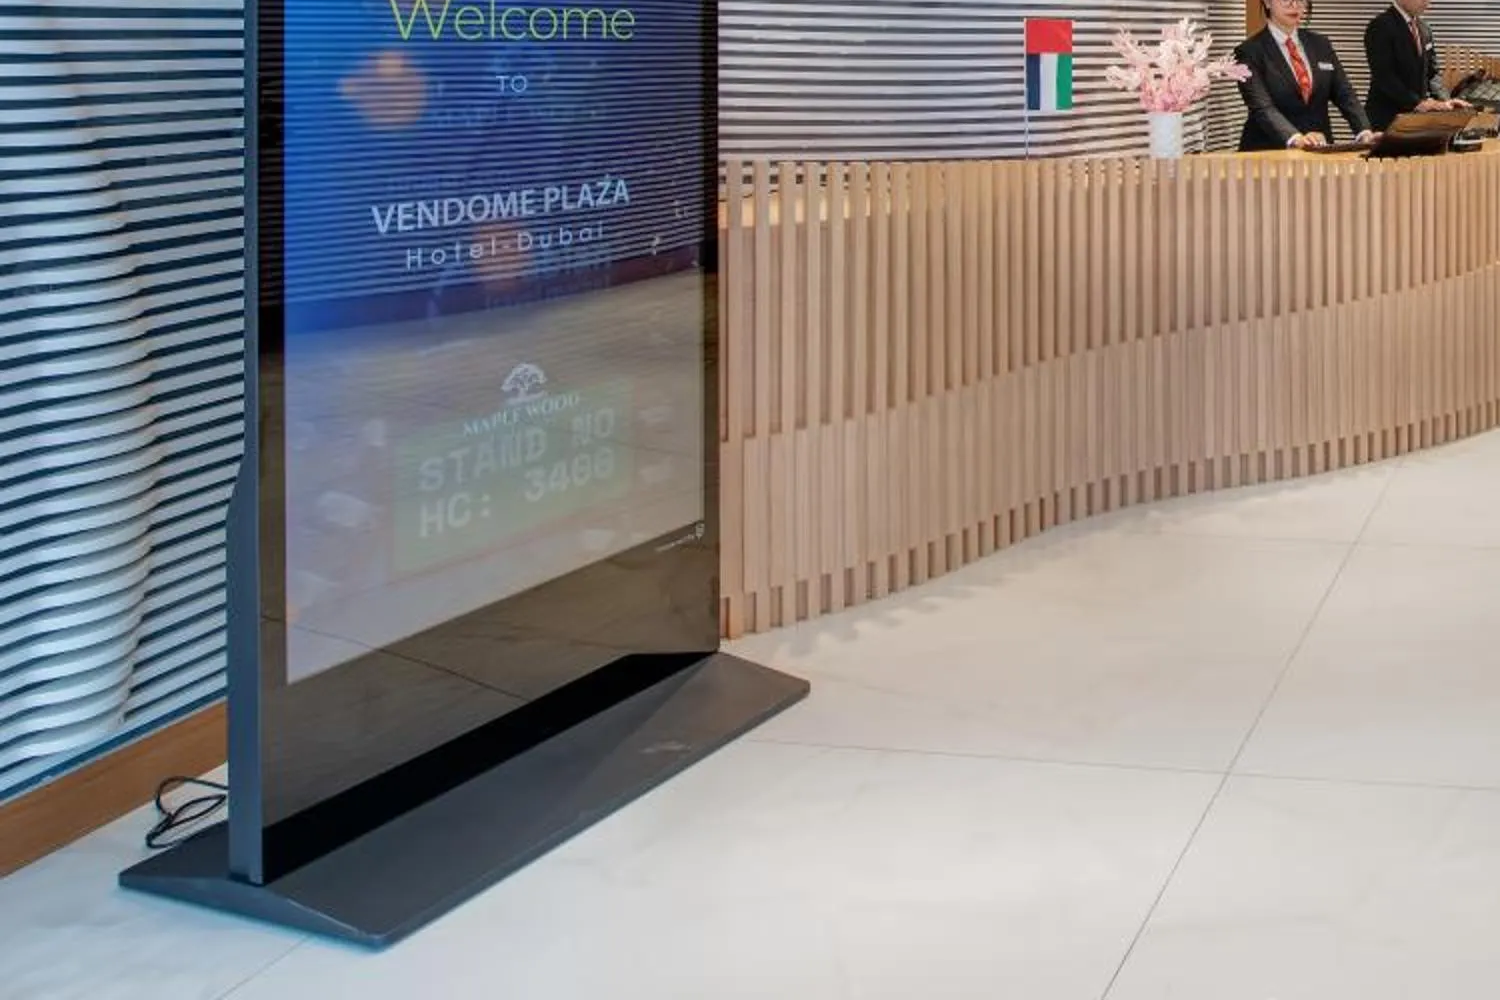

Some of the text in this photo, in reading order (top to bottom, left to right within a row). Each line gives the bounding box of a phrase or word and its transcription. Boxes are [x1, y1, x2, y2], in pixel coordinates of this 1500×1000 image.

[495, 75, 528, 93] TO
[371, 189, 536, 235] VENDOME
[418, 427, 548, 492] STAND
[418, 492, 492, 539] HC:
